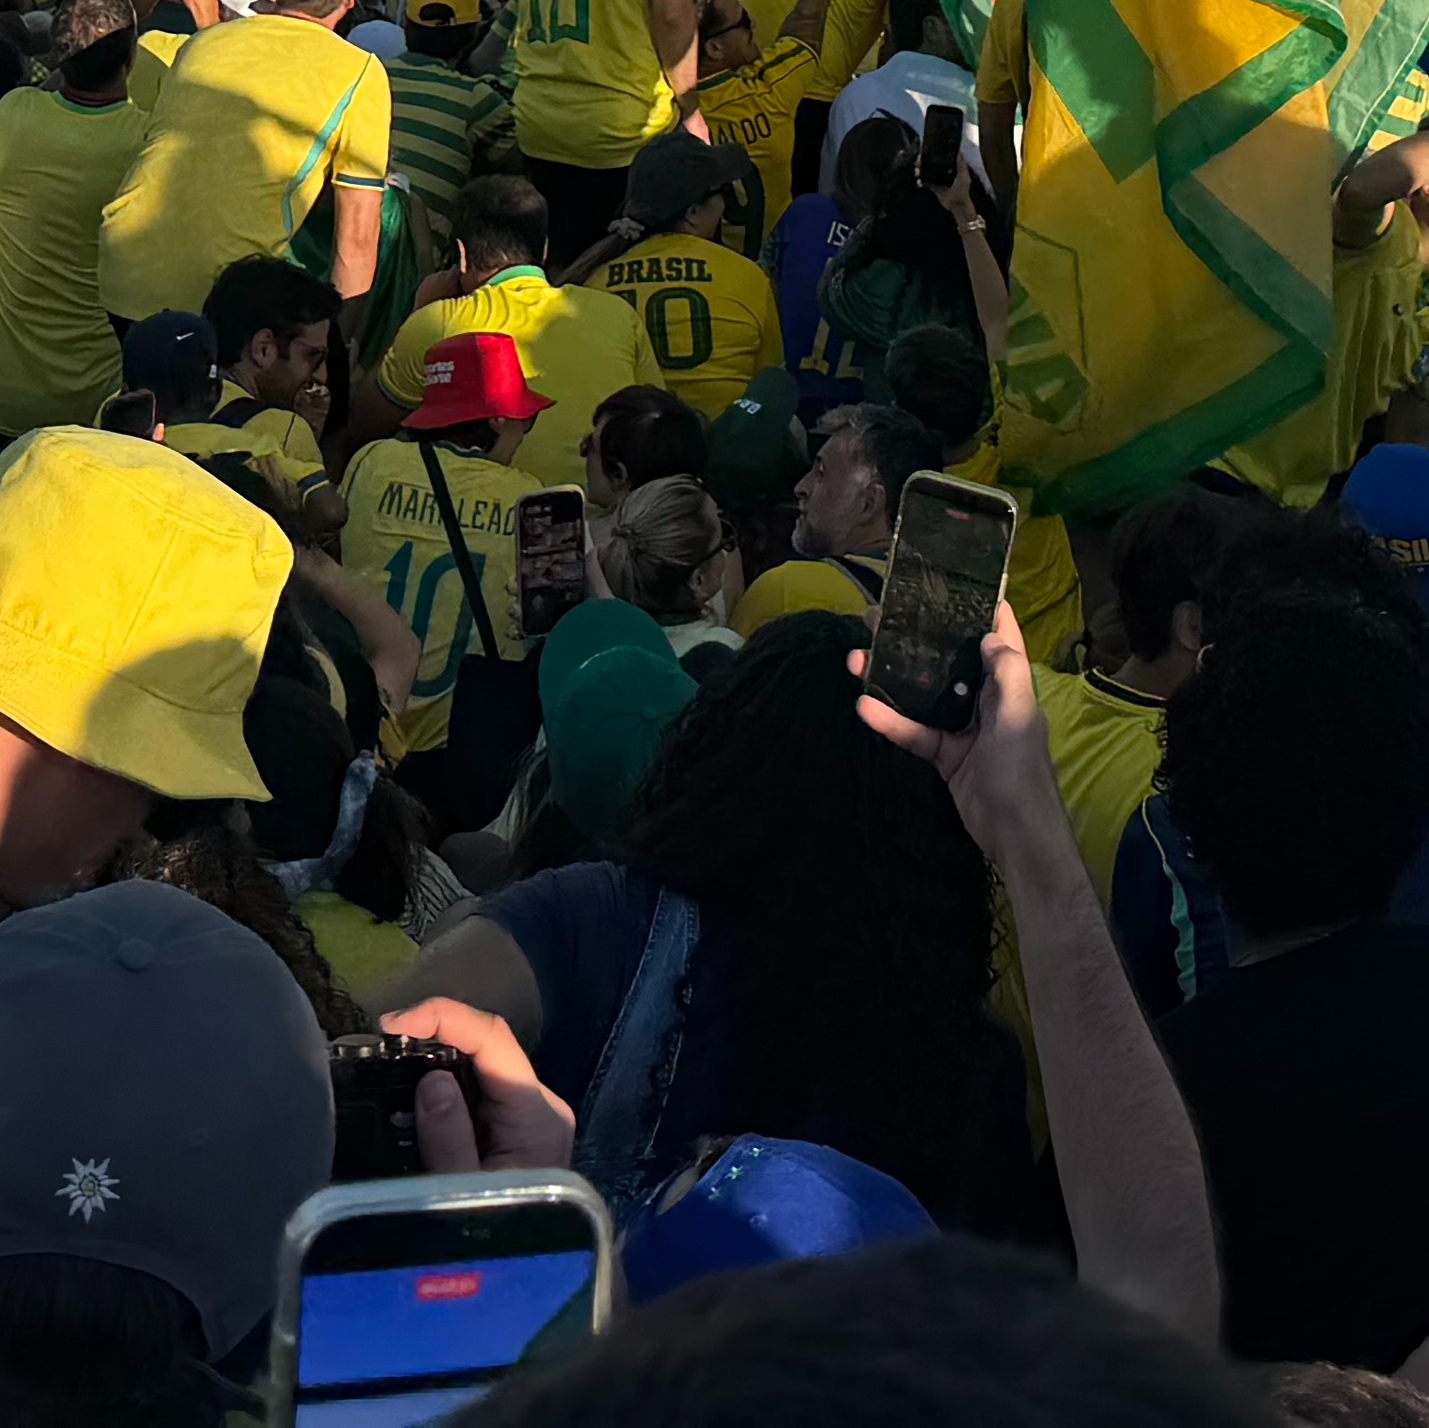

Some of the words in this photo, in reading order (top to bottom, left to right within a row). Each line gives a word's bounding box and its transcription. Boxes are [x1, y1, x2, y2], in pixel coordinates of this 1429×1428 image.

[605, 256, 713, 288] BRASIL
[612, 286, 713, 370] 0
[377, 481, 443, 526] MAR
[383, 540, 487, 698] 10
